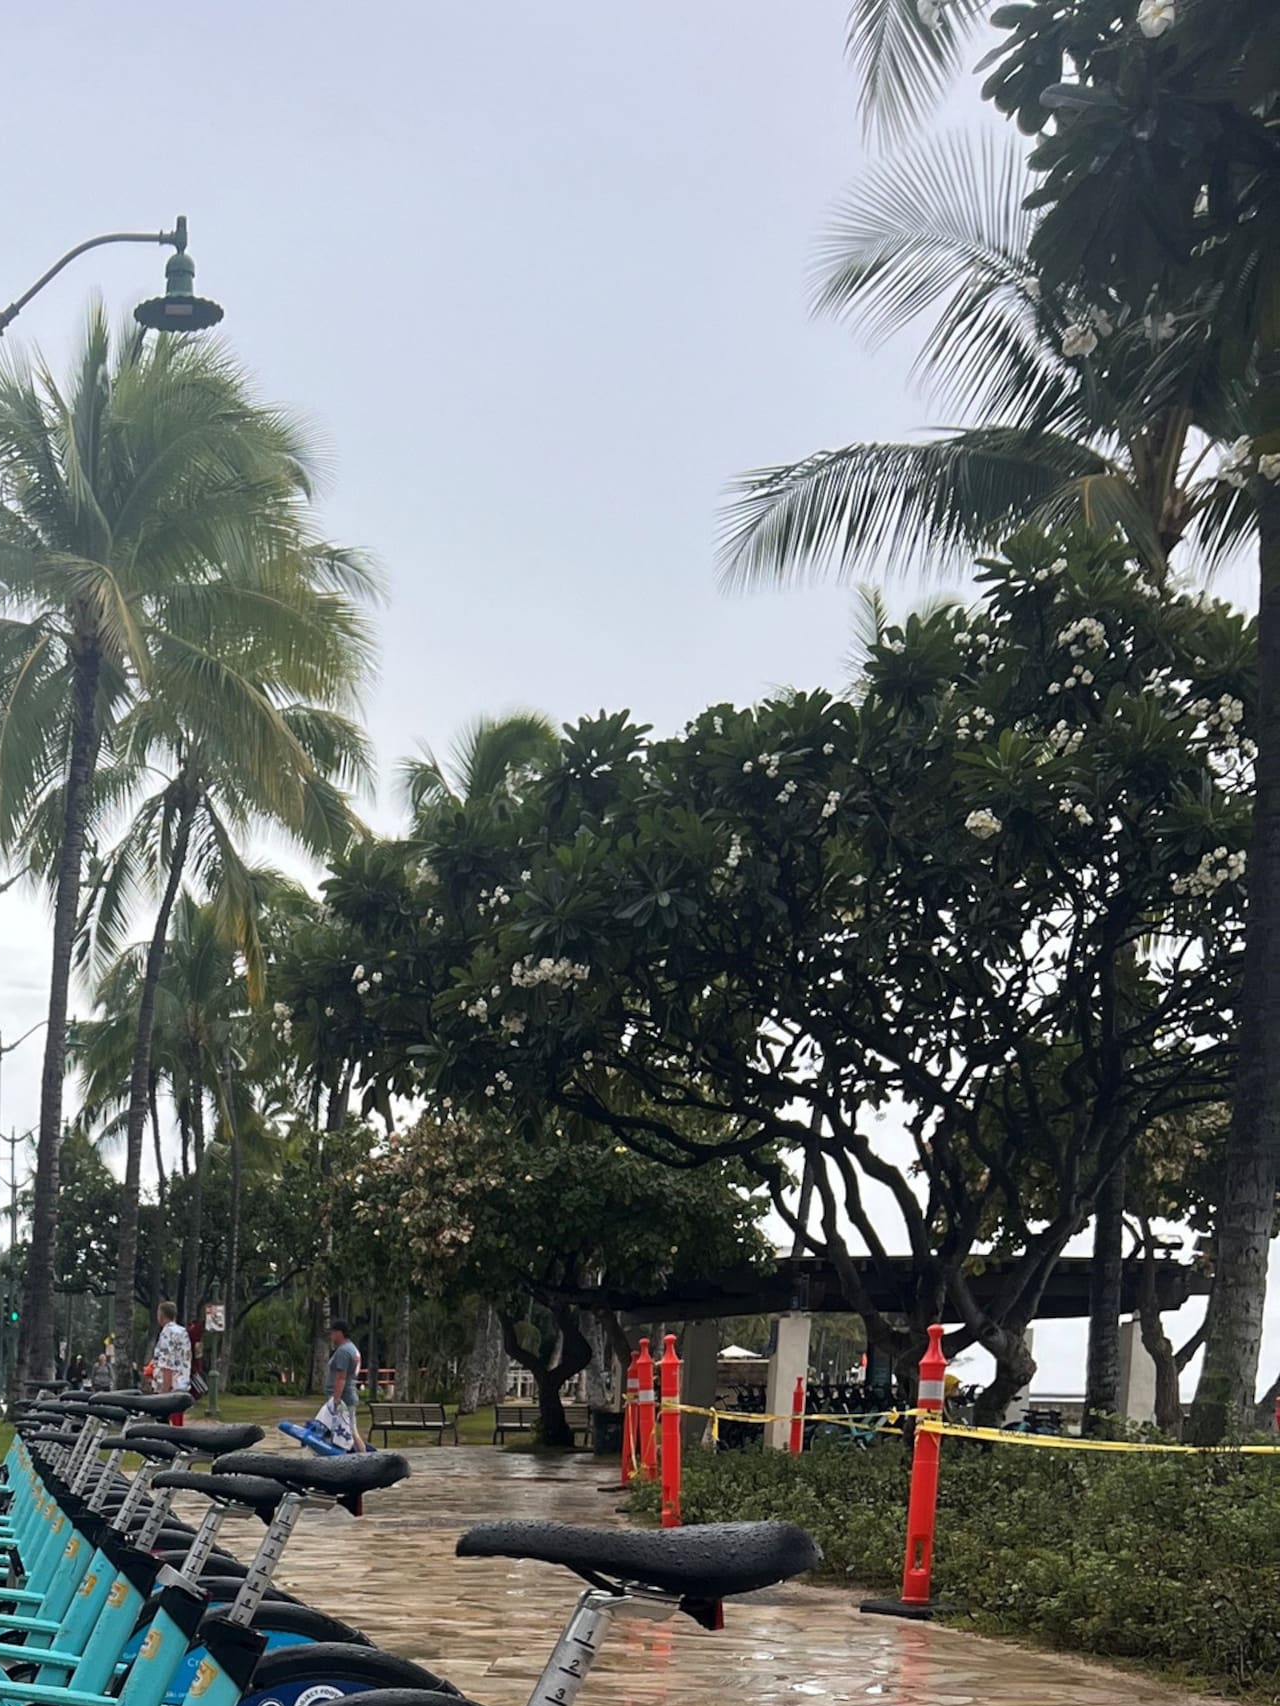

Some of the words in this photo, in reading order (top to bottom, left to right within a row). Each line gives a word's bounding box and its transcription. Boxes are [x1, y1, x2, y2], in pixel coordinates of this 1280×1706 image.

[587, 1630, 594, 1641] 1
[569, 1660, 580, 1672] 2
[555, 1688, 565, 1700] 3
